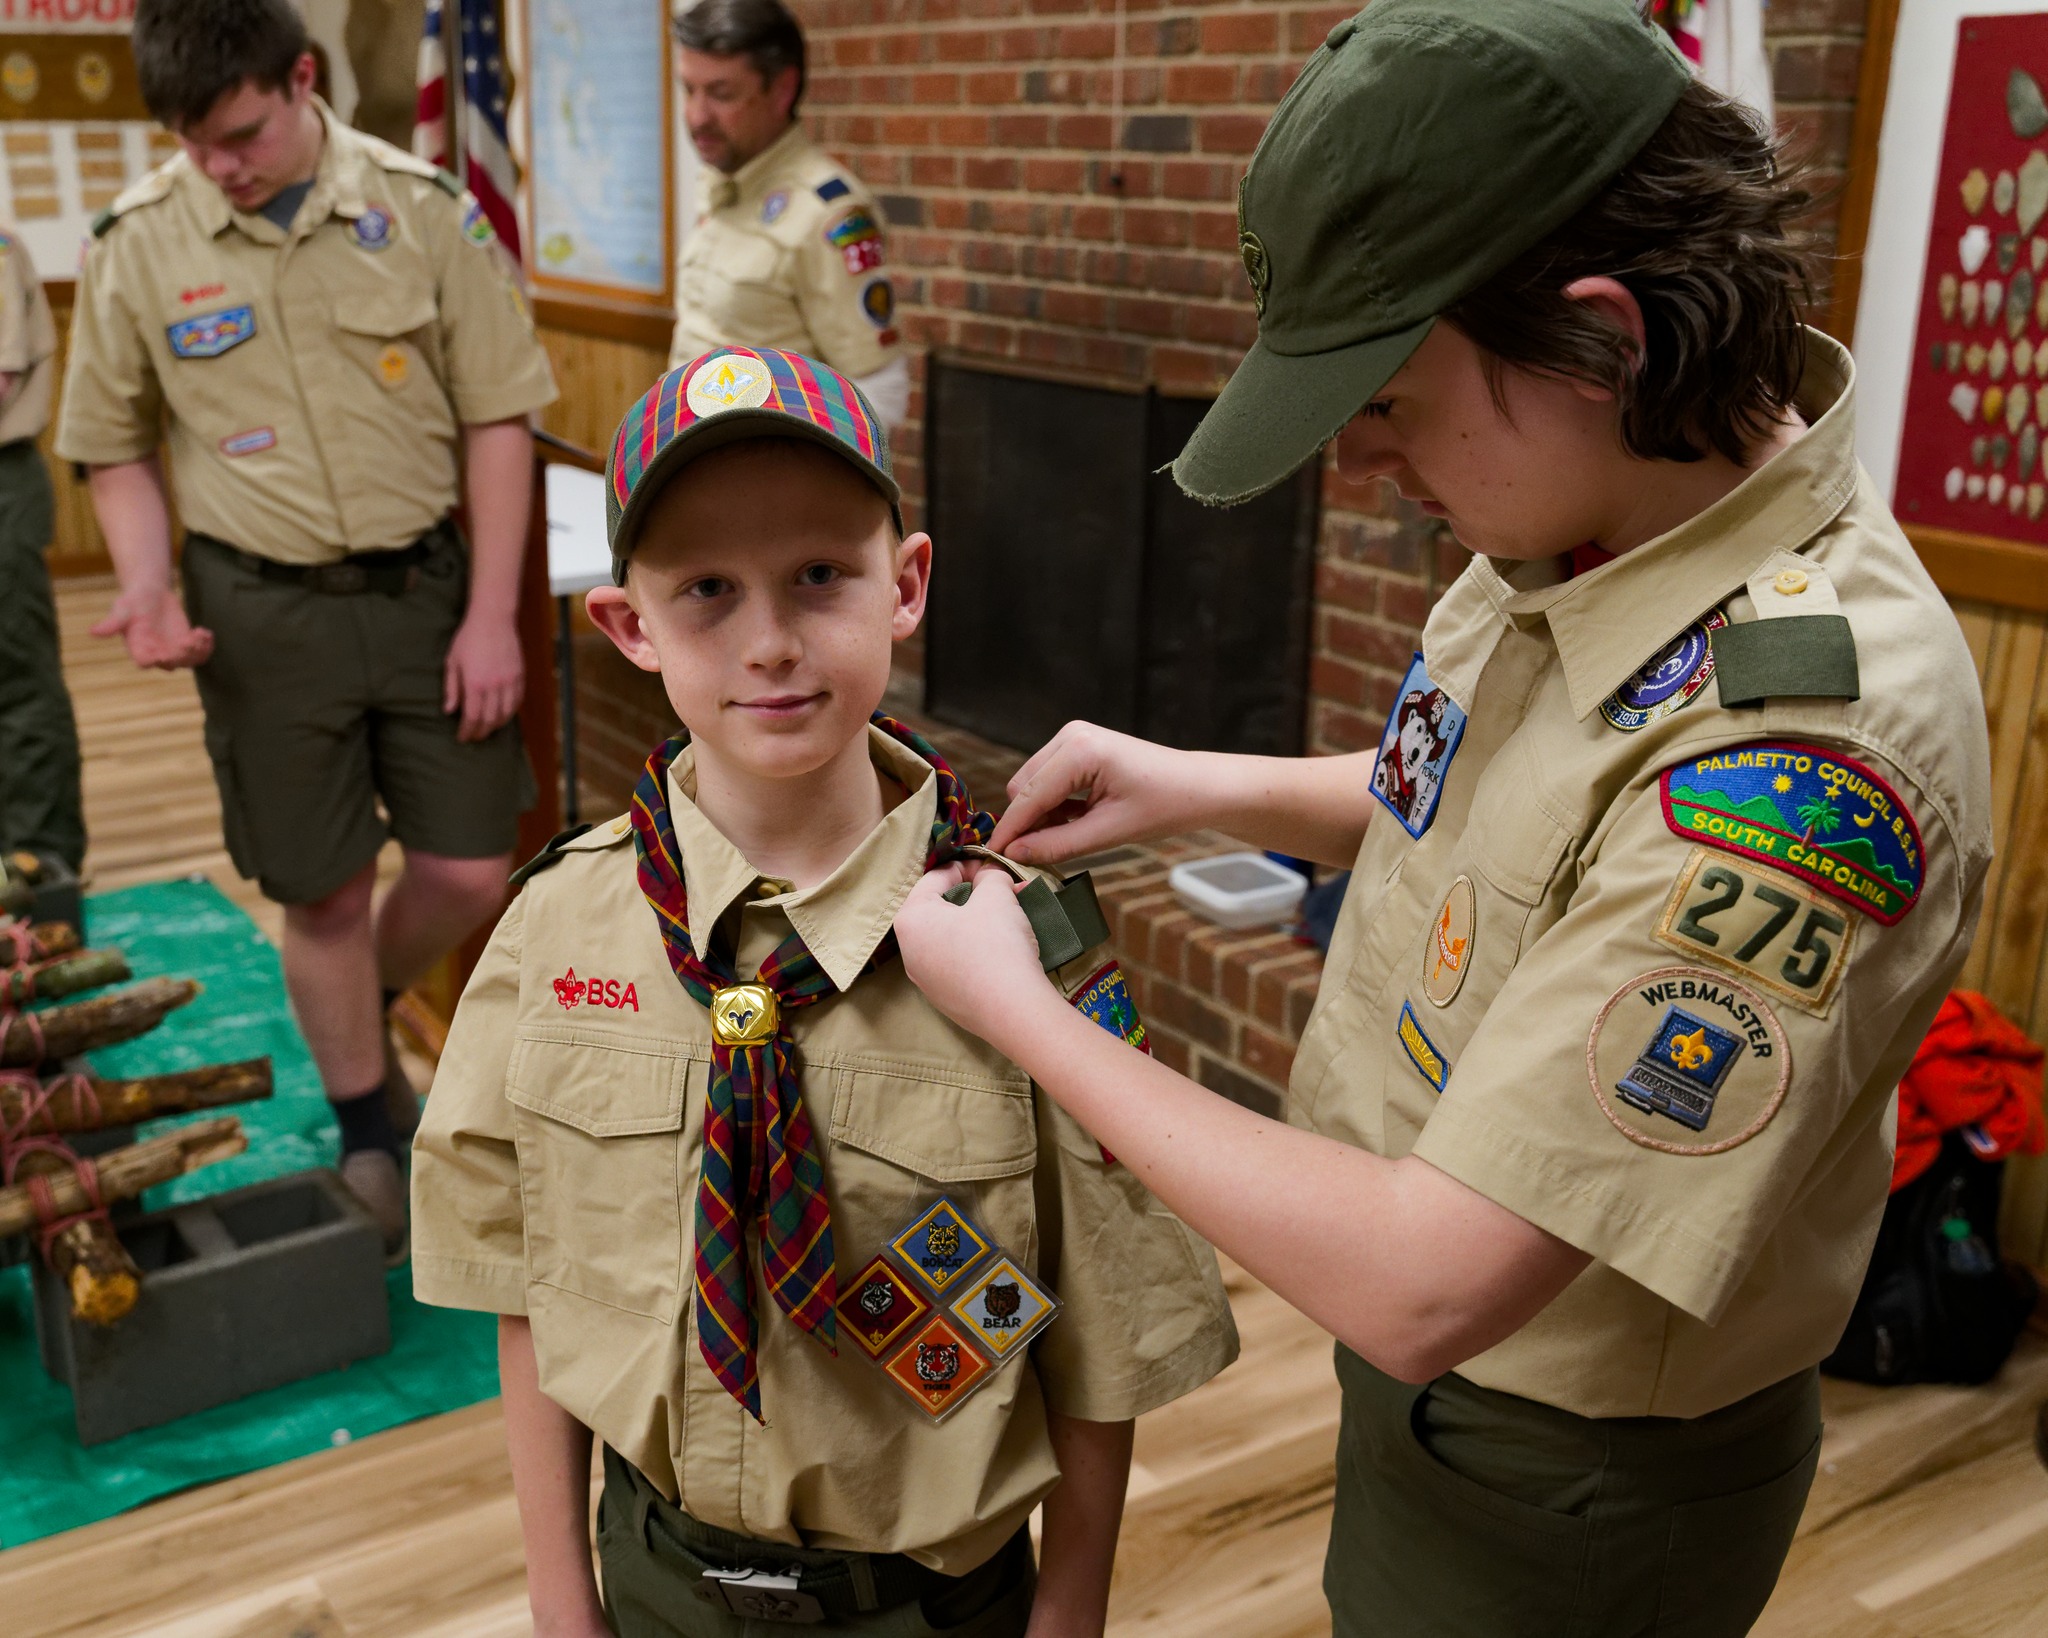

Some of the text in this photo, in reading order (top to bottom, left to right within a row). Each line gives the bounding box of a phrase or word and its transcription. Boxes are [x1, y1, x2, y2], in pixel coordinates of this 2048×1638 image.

[1615, 710, 1640, 725] 1910
[1696, 752, 1812, 774] PALMETTO
[1818, 762, 1890, 821] COUNCIL
[1692, 812, 1888, 908] SOUTH CAROLINA
[1676, 866, 1847, 989] 275
[587, 978, 639, 1012] BSA
[1639, 980, 1772, 1058] WEBMASTER
[921, 1257, 964, 1268] BOBCAT
[983, 1317, 1021, 1329] BEAR
[923, 1383, 951, 1391] TIGER
